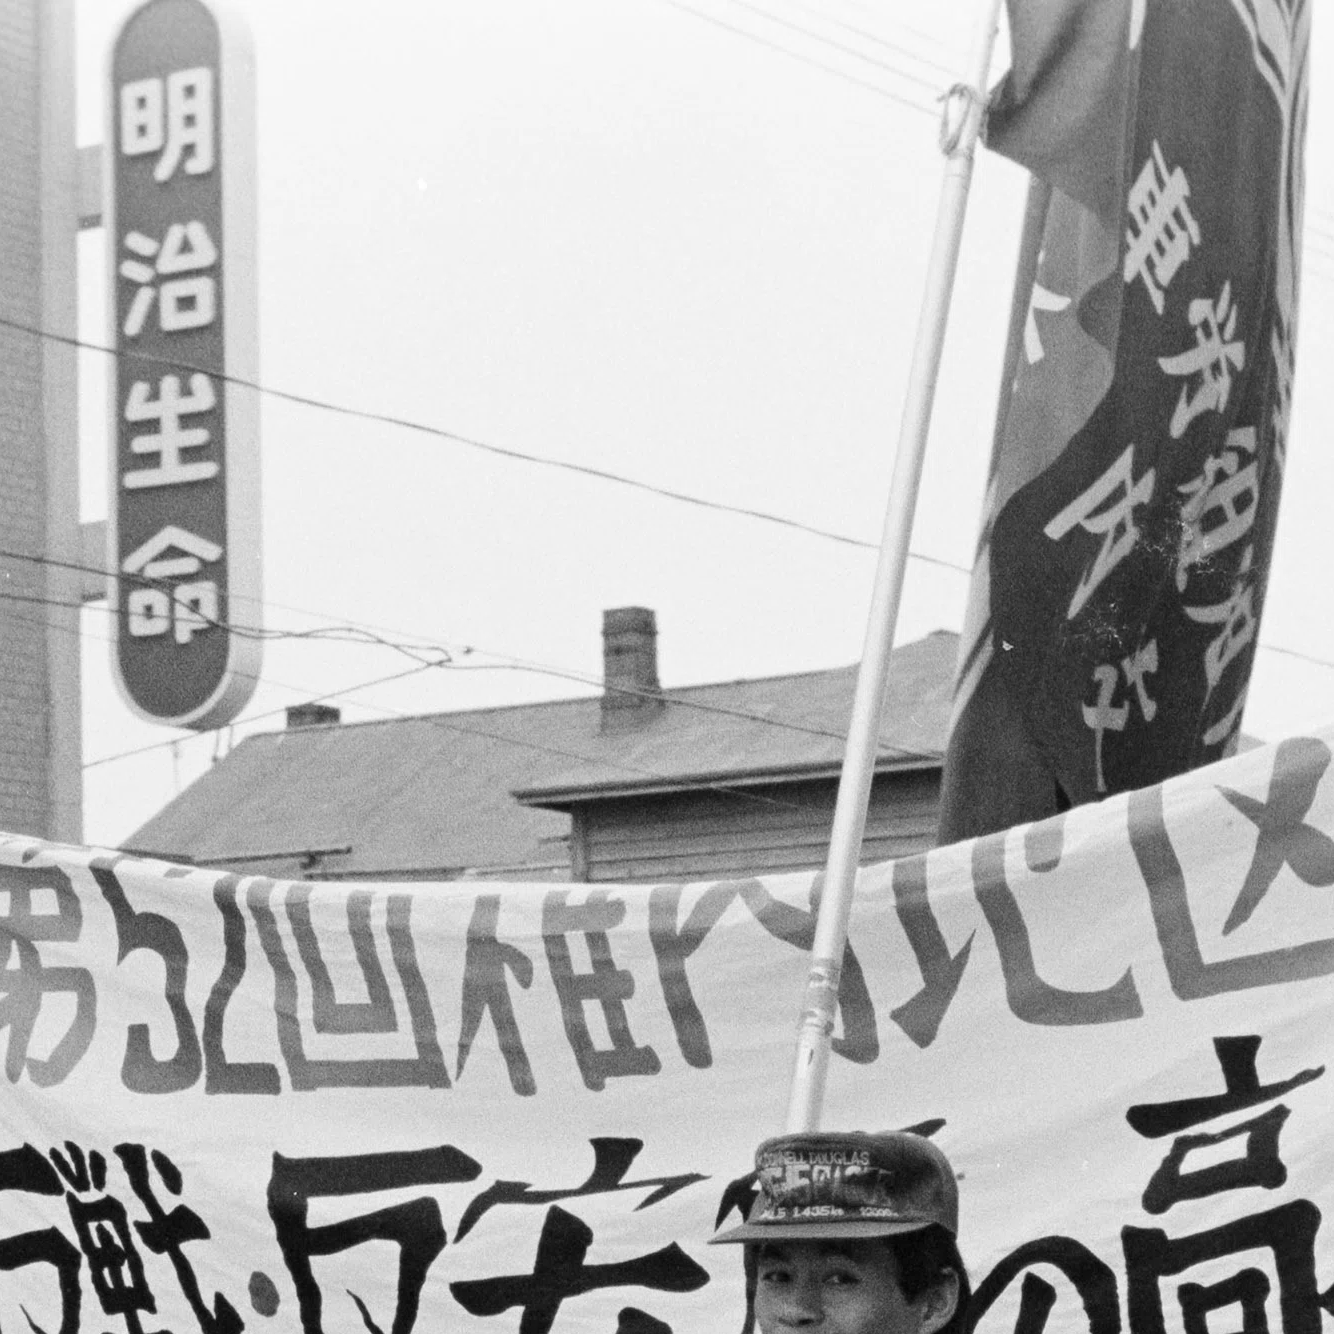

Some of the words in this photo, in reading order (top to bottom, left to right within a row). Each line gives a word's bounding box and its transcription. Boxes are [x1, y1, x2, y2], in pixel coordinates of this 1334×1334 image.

[121, 66, 223, 644] 明治生命
[809, 1150, 871, 1166] DOUGLAS
